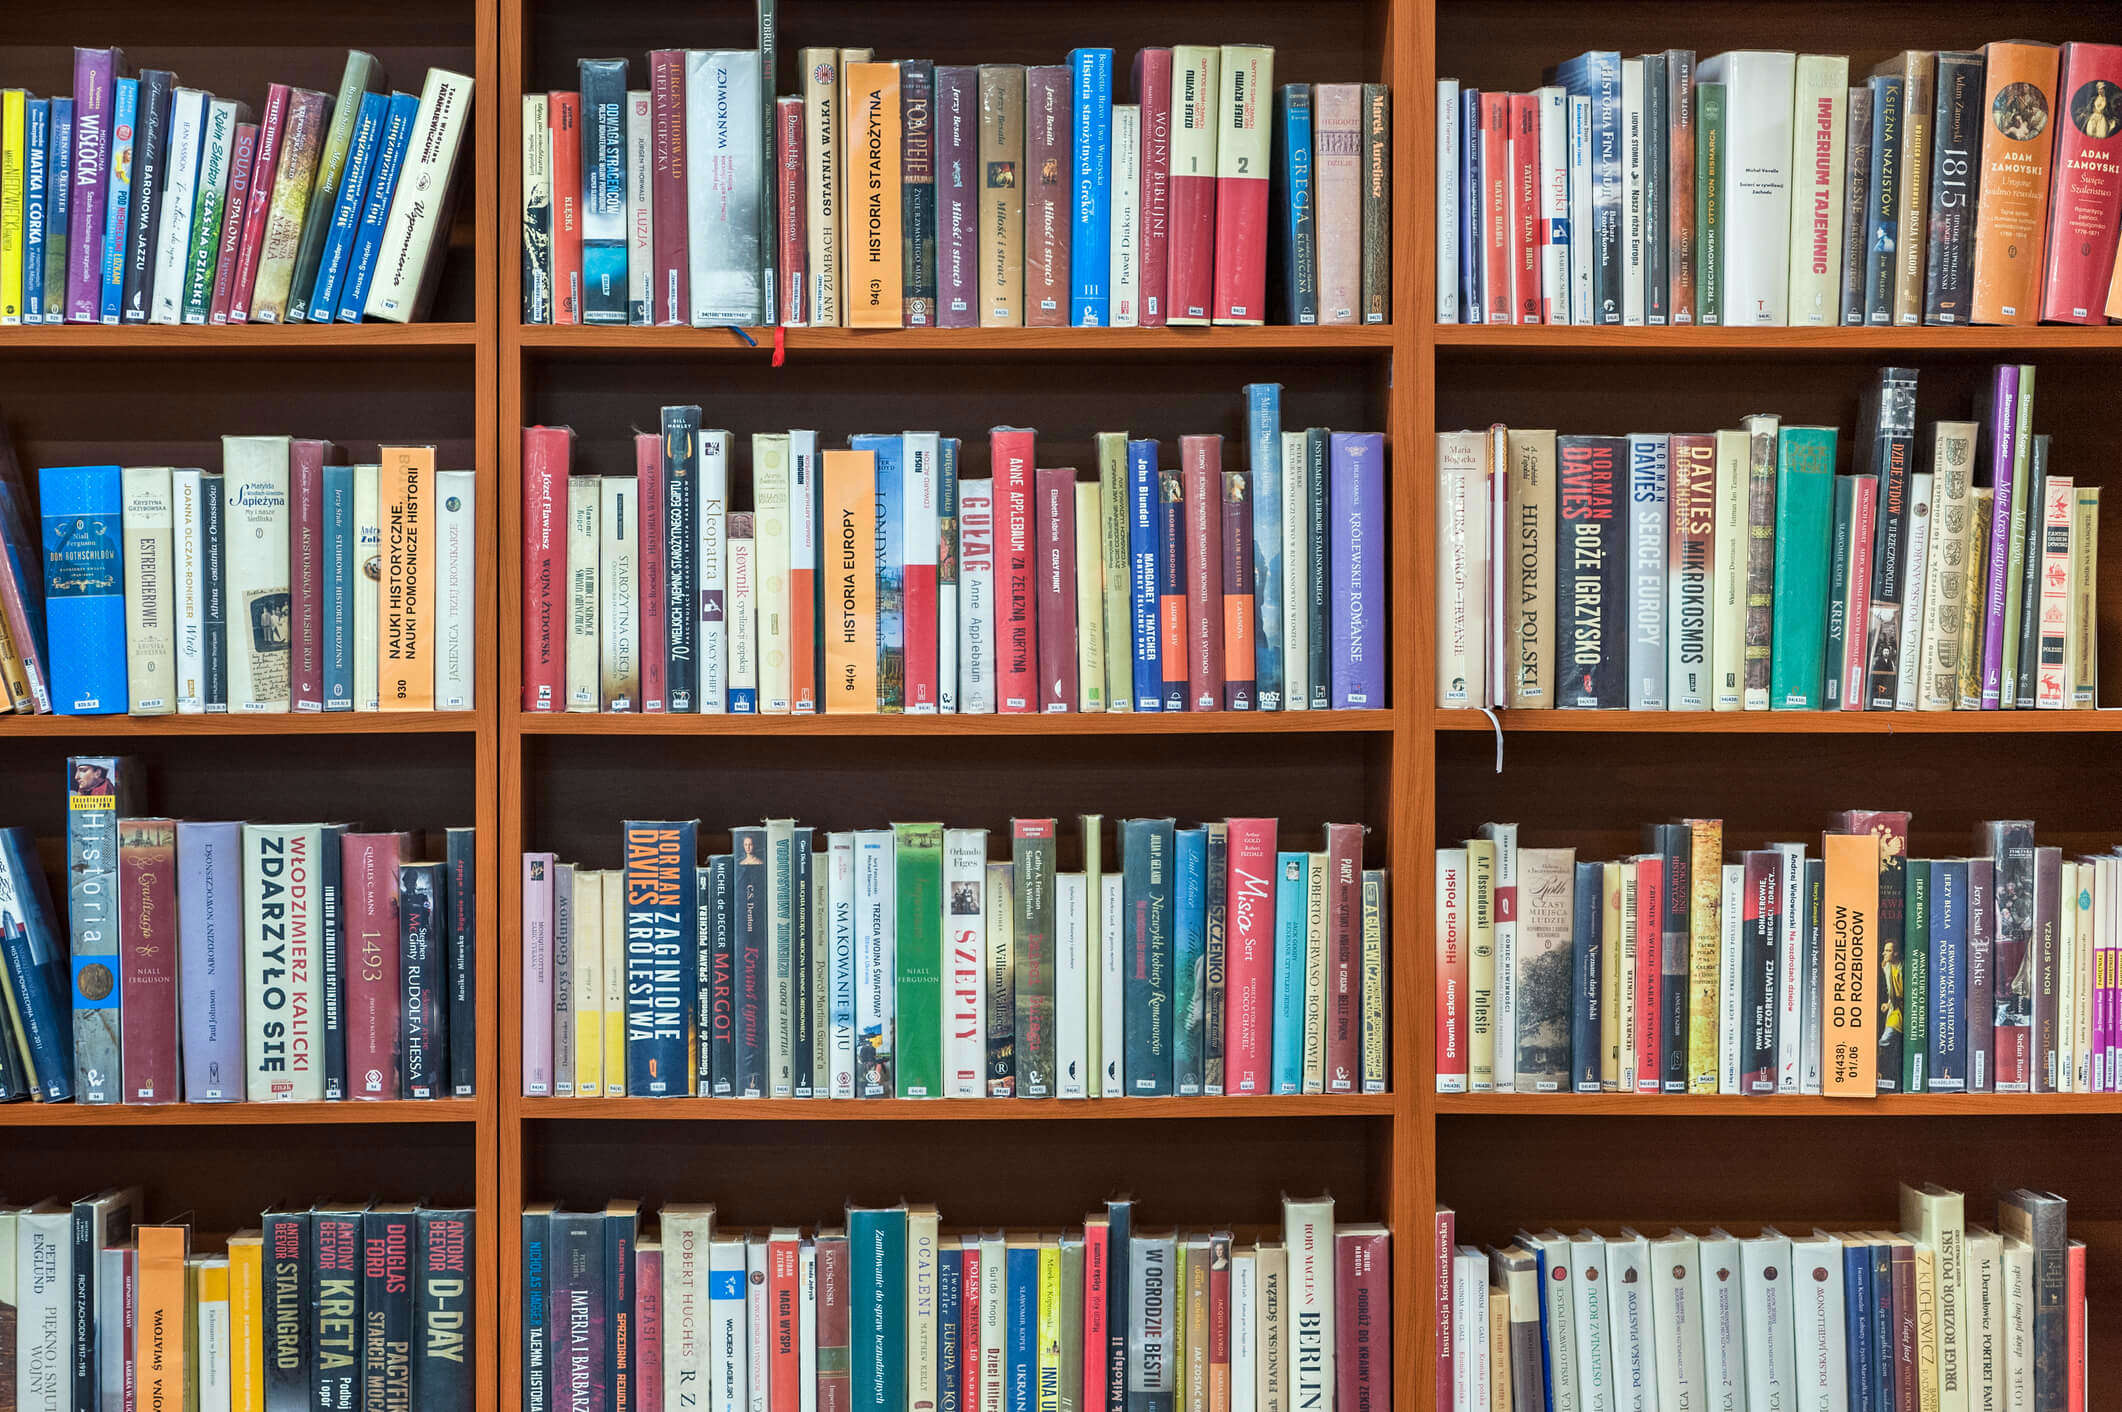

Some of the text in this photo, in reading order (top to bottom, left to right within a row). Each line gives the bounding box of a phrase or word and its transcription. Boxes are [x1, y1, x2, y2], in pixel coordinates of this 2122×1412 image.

[77, 114, 100, 185] WISŁOCKA
[421, 83, 448, 164] TATARKIEWICZOWIE
[718, 68, 727, 149] WAŃKOWICZ
[1372, 95, 1384, 198] Marek Aureliusz
[1631, 112, 1639, 168] LUDWIK STOMMA
[1815, 97, 1833, 184] IMPERIUM
[31, 148, 43, 191] MATKA
[822, 99, 831, 217] OSTATNIA WALKA
[867, 89, 881, 263] HISTORIA STAROŻYTNA
[1154, 112, 1167, 239] WOJNY BIBLIJNE
[1238, 157, 1248, 173] 2
[1882, 86, 1898, 216] KSIĘŻNA NAZISTÓW
[1940, 149, 1968, 208] 1815
[1991, 163, 2043, 176] ZAMOYSKI
[2004, 152, 2033, 162] ADAM
[2067, 159, 2120, 174] ZAMOYSKI
[2081, 149, 2110, 160] ADAM
[29, 202, 42, 244] CÓRKA
[136, 165, 153, 271] BARONOWA JAZZU
[192, 191, 216, 306] CZAS NA DZIAŁKĘ
[393, 199, 425, 287] Wspomnienia
[637, 208, 648, 249] ILUZJA
[1813, 190, 1829, 275] TAJEMNIC
[352, 240, 372, 299] Janusz Świąder
[824, 227, 833, 321] JAN ZUMBACH
[870, 279, 882, 306] 94(3)
[541, 472, 552, 550] Józef Flawiusz
[1009, 458, 1025, 551] ANNE APPLEBAUM
[1137, 459, 1149, 528] John Blundell
[1562, 447, 1593, 520] DAVIES
[1593, 447, 1613, 519] NORMAN
[1635, 442, 1656, 502] DAVIES
[1656, 443, 1665, 502] NORMAN
[184, 483, 194, 618] JOANNA OLCZAK-RONIKIER
[389, 501, 403, 660] NAUKI HISTORYCZNE.
[406, 467, 418, 660] NAUKI POMOCNICZE HISTORII
[706, 499, 722, 580] Kleopatra
[843, 509, 855, 643] HISTORIA EUROPY
[1638, 511, 1661, 647] SERCE EUROPY
[140, 538, 157, 628] ESTREICHEROWIE
[540, 558, 551, 665] WOJNA ŻYDOWSKA
[1144, 553, 1156, 660] MARGARET THATCHER
[1349, 512, 1363, 662] KRÓLEWSKIE ROMANSE
[1521, 504, 1538, 687] HISTORIA POLSKI
[1574, 523, 1607, 664] BOŻE IGRZYSKO
[1680, 541, 1705, 664] MIKROKOSMOS
[1830, 600, 1843, 641] KRESY
[971, 580, 980, 683] Anne Applebaum
[397, 679, 407, 699] 930
[846, 664, 856, 691] 94(4)
[82, 813, 106, 943] Historia
[628, 829, 659, 906] DAVIES
[658, 830, 681, 906] NORMAN
[207, 920, 215, 975] NARODZINY
[259, 837, 286, 1072] ZDARZYŁO SIĘ
[291, 836, 308, 1071] WŁODZIMIERZ KALICKI
[361, 930, 383, 982] 1493
[1235, 868, 1269, 961] Misia Sert
[1446, 869, 1457, 965] Historia Polski
[2044, 921, 2052, 962] SFORZA
[628, 912, 654, 1041] KRÓLESTWA
[654, 913, 681, 1040] ZAGINIONE
[714, 953, 730, 1043] MARGOT
[836, 902, 850, 1051] SMAKOWANIE RAJU
[955, 930, 977, 1043] SZEPTY
[1307, 866, 1322, 1072] ROBERTO GERVASO BORGIOWIE
[1763, 959, 1774, 1050] WIECZORKIEWICZ
[1833, 905, 1848, 1027] OD PRADZIEJÓW
[1850, 911, 1864, 1027] DO ROZBIORÓW
[408, 966, 421, 1080] RUDOLFA HESSA
[1446, 979, 1458, 1059] Słownik szkolny
[1475, 989, 1491, 1034] Polesie
[1835, 1040, 1847, 1083] 94(438).
[1849, 1046, 1858, 1078] 01/.06
[34, 1233, 43, 1294] ENGLUND
[46, 1244, 56, 1284] PETER
[275, 1224, 287, 1259] BEEVOR
[287, 1222, 298, 1259] ANTONY
[320, 1222, 336, 1269] BEEVOR
[338, 1223, 354, 1271] ANTONY
[366, 1239, 385, 1278] FORD
[386, 1224, 406, 1294] DOUGLAS
[429, 1221, 446, 1271] BEEVOR
[447, 1220, 464, 1272] ANTONY
[919, 1237, 930, 1317] OCALENI
[276, 1263, 299, 1369] STALINGRAD
[320, 1280, 354, 1370] KRETA
[427, 1279, 464, 1363] D-DAY
[682, 1231, 694, 1357] ROBERT HUGHES
[779, 1290, 791, 1354] NAGA WYSPA
[1144, 1249, 1163, 1388] W OGRODZIE BESTII
[1439, 1222, 1450, 1357] Insurekcja kościuszkowska
[1942, 1230, 1957, 1392] DRUGI ROZBIÓR POLSKI
[530, 1328, 542, 1368] TAJEMNA
[1266, 1273, 1278, 1392] FRANCUSKA ŚCIEŻKA
[1300, 1313, 1321, 1408] BERLIN
